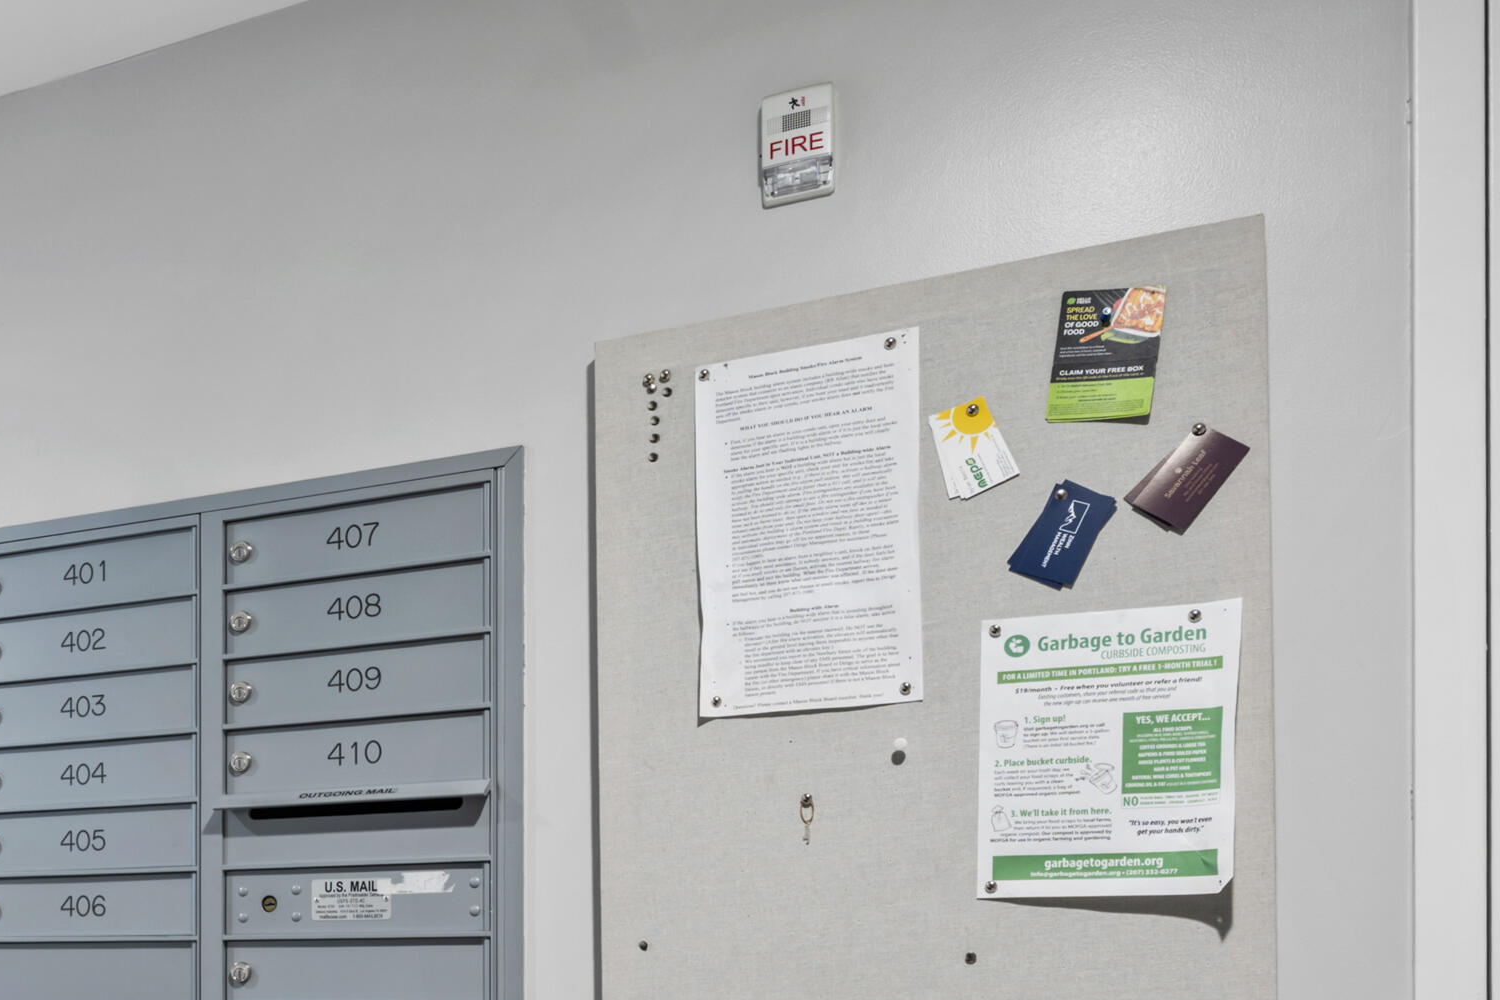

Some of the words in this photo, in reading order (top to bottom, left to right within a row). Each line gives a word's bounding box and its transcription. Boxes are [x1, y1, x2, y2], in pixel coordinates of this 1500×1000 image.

[770, 131, 823, 160] FIRE
[326, 521, 380, 550] 407
[1053, 533, 1068, 555] WEALTH
[1041, 531, 1062, 568] MANAGEMENT
[63, 559, 106, 586] 401
[326, 592, 382, 621] 408
[60, 627, 107, 653] 402
[1037, 633, 1112, 652] Garbage
[1117, 632, 1135, 646] to
[1140, 625, 1207, 644] Garden
[1101, 648, 1144, 660] CURBSIDE
[1146, 643, 1206, 656] COMPOSTING
[327, 666, 382, 693] 409
[1023, 671, 1050, 679] LIMITED
[1078, 667, 1117, 676] PORTLAND:
[1157, 662, 1191, 670] 1-MONTH
[1192, 660, 1212, 668] TRIAL
[60, 693, 107, 719] 403
[1033, 715, 1050, 725] Sign
[1052, 714, 1066, 723] up!
[1136, 715, 1154, 725] YES,
[1155, 714, 1170, 723] WE
[1171, 712, 1211, 722] ACCEPT...
[327, 739, 383, 767] 410
[1004, 759, 1025, 767] Place
[1027, 757, 1053, 766] bucket
[1055, 756, 1092, 765] curbside.
[60, 761, 107, 786] 404
[299, 789, 363, 799] OUTGOING
[1123, 796, 1139, 806] NO
[1020, 809, 1039, 817] We'll
[1041, 808, 1059, 816] take
[1060, 808, 1067, 816] it
[1090, 807, 1112, 815] here.
[60, 828, 107, 852] 405
[1044, 856, 1164, 871] garbagetogarden.org
[325, 881, 346, 893] U.S.
[350, 880, 378, 892] MAIL
[60, 894, 107, 918] 406
